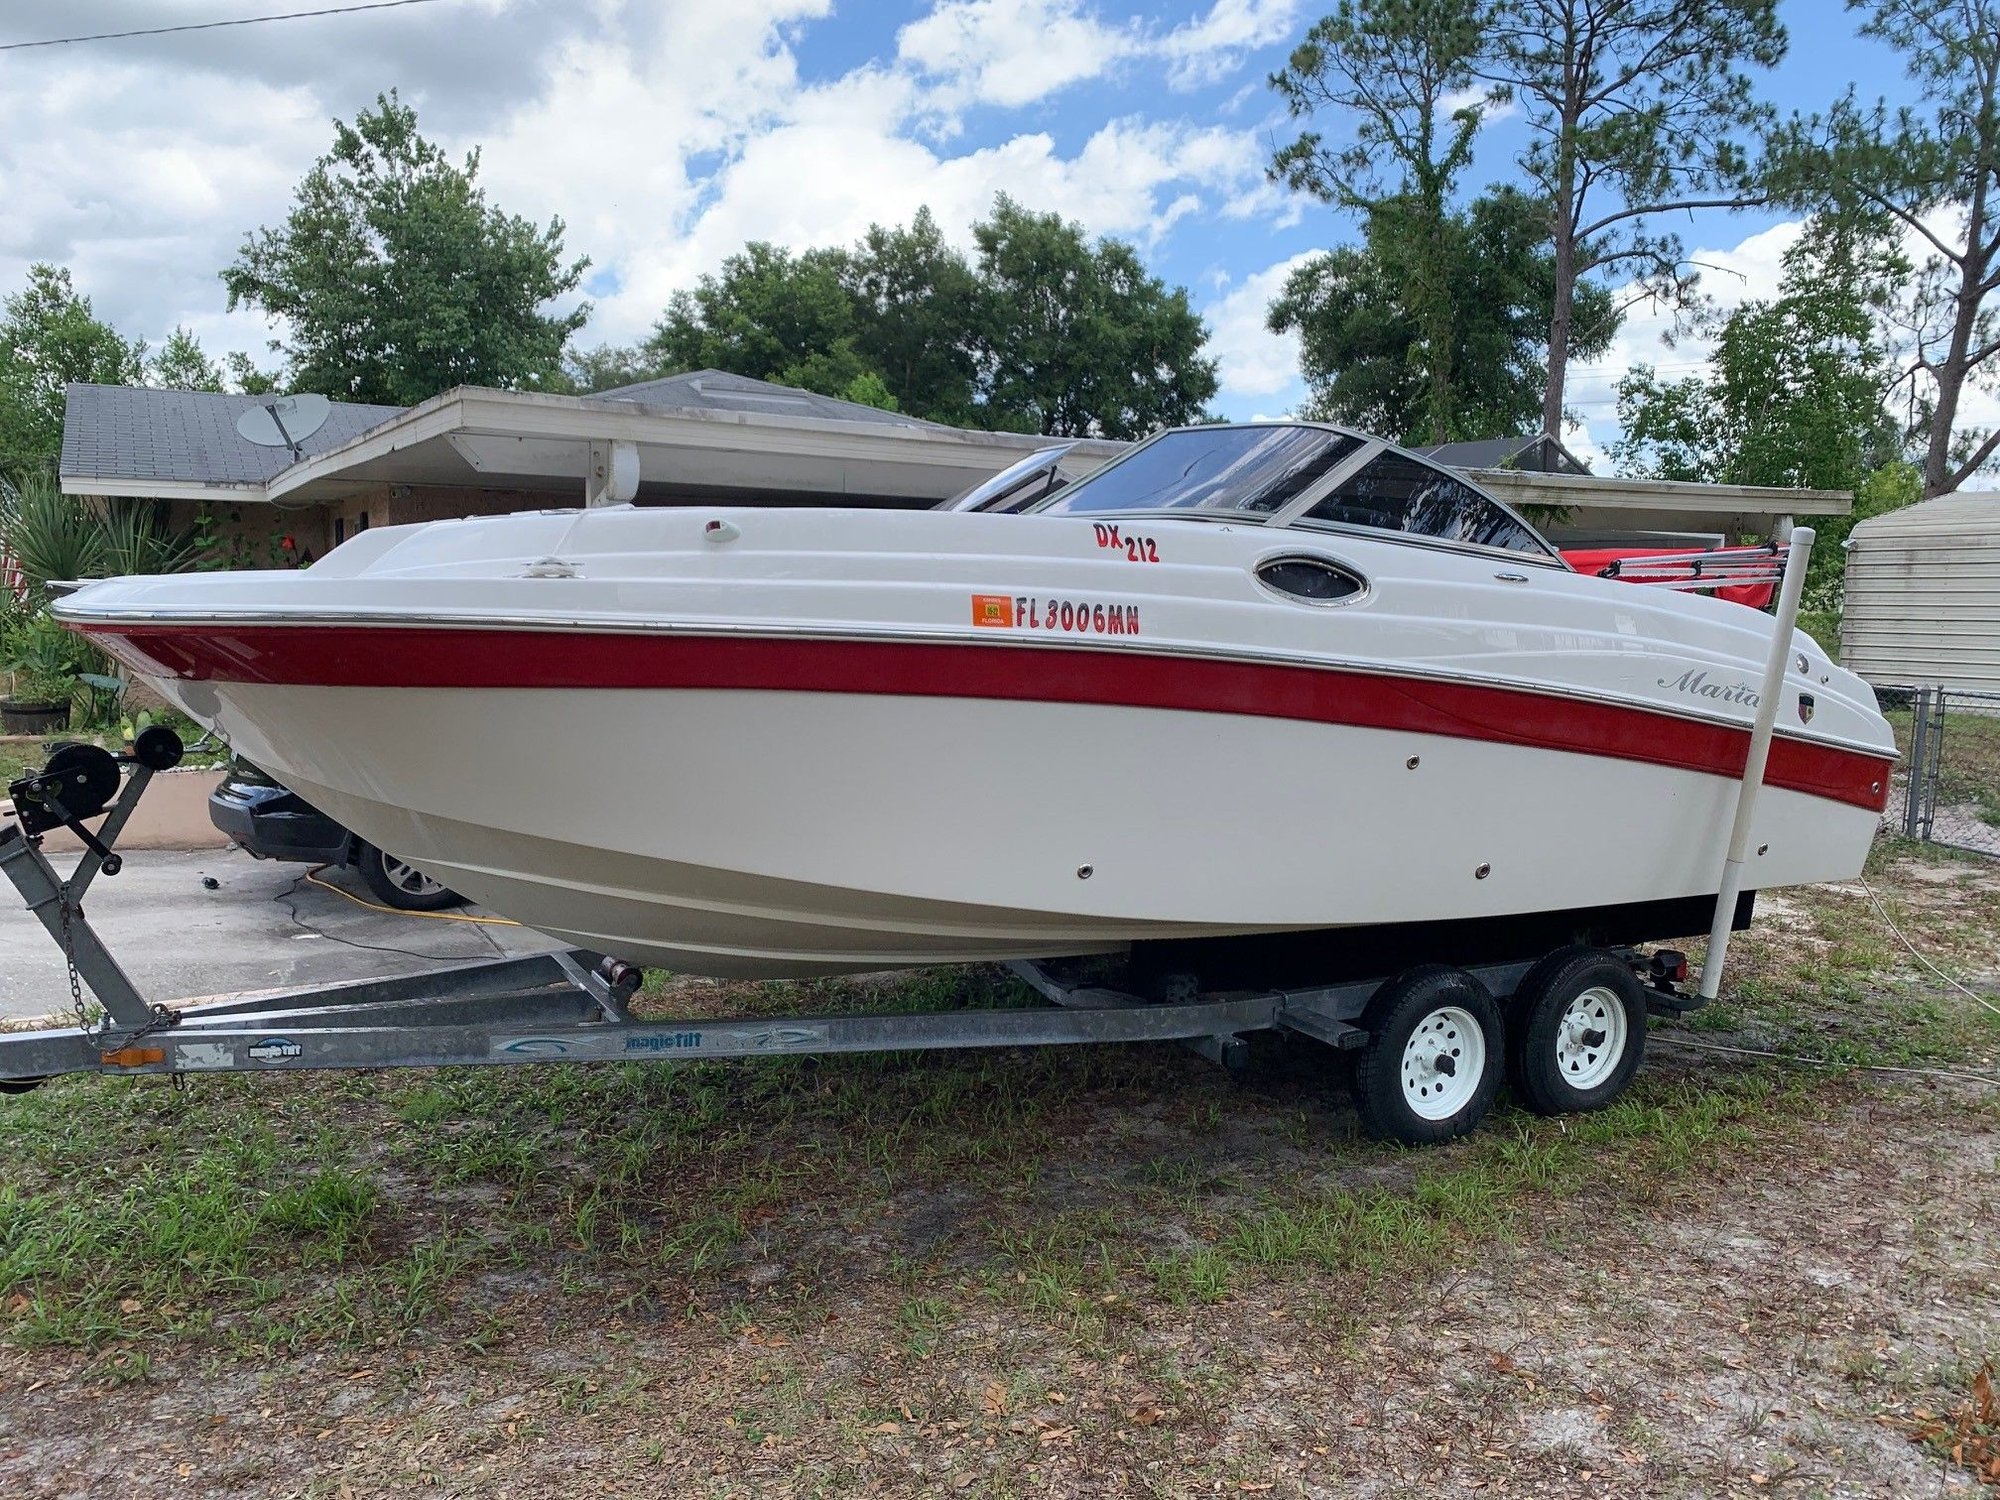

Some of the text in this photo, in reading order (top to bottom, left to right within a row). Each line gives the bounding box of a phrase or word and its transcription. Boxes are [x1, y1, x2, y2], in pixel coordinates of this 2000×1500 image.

[1093, 522, 1160, 562] DX 212
[1016, 597, 1140, 635] FL 3006MN
[1657, 668, 1761, 709] Maria
